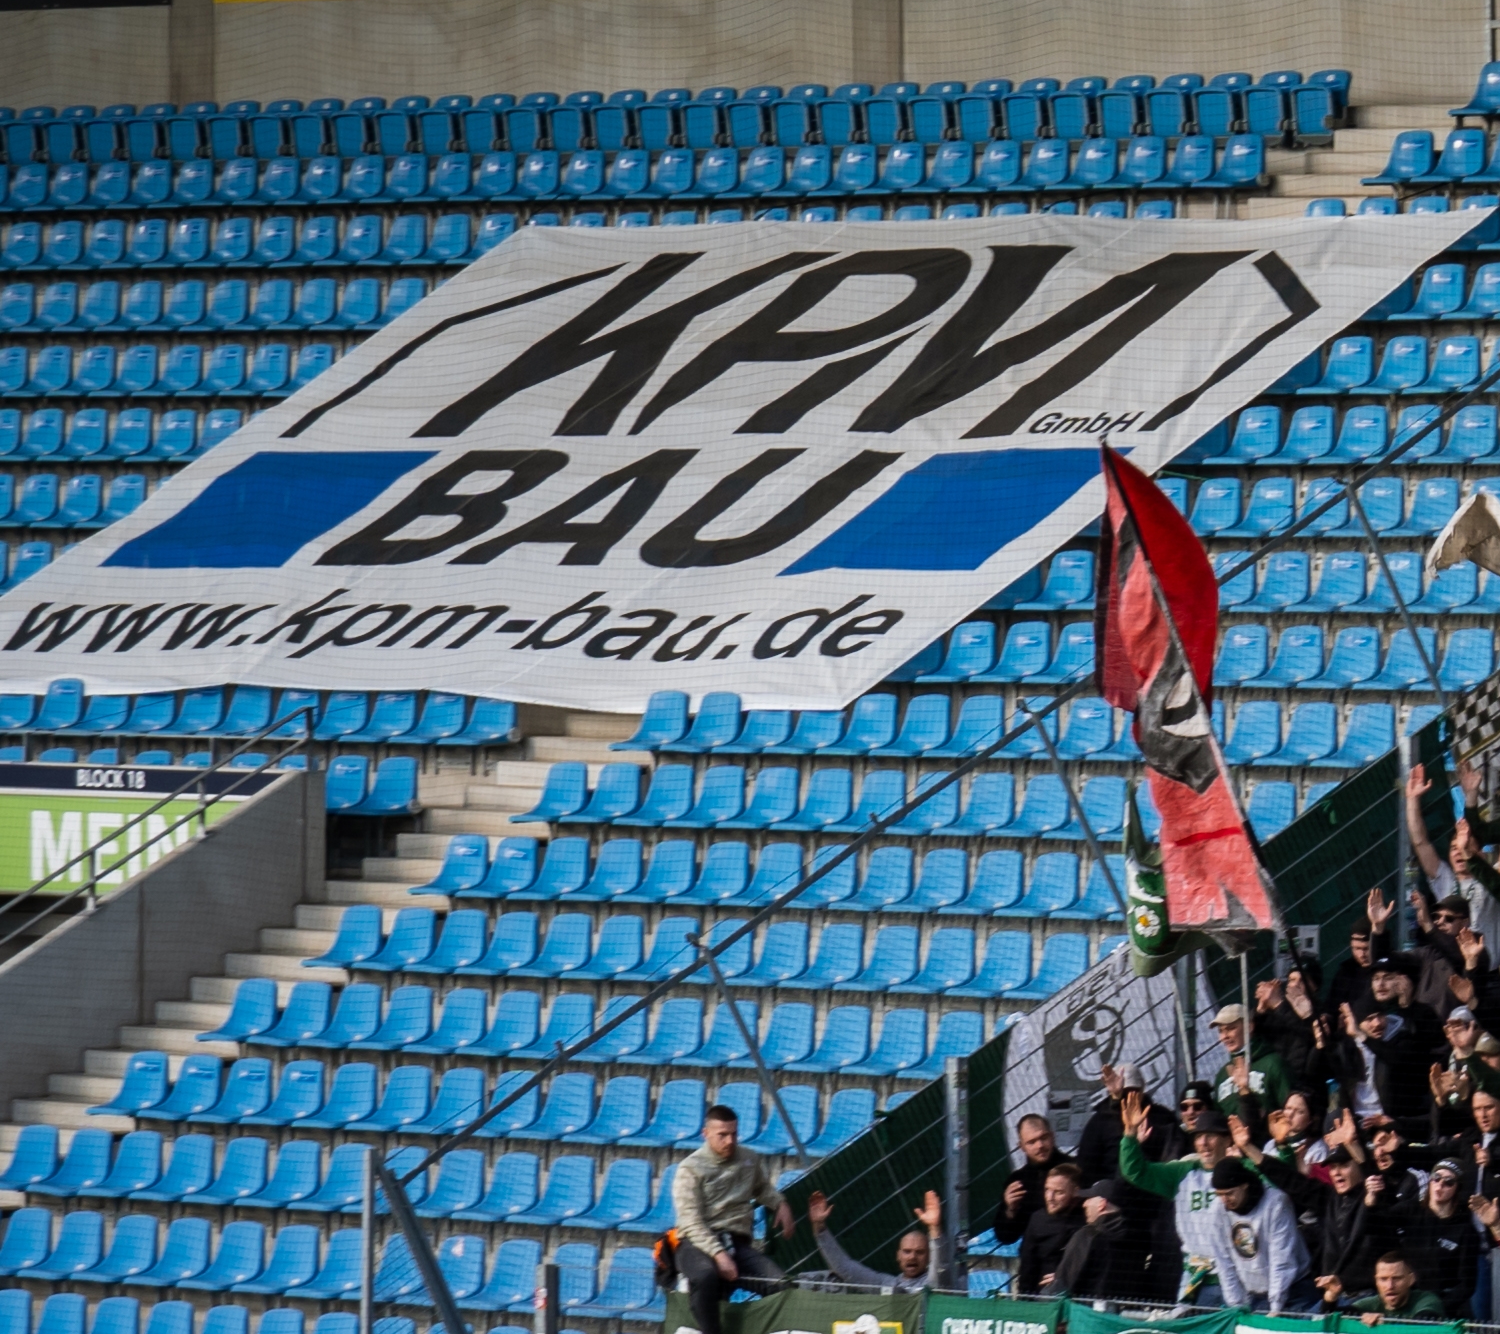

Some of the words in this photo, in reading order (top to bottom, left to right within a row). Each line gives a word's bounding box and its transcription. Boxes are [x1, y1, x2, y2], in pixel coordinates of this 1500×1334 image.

[410, 244, 1259, 440] KPM
[1028, 410, 1146, 437] GmbH
[312, 447, 906, 568] BAU
[2, 588, 905, 662] www.kpm-bau.de
[76, 769, 125, 789] BLOCK
[126, 770, 147, 789] 18
